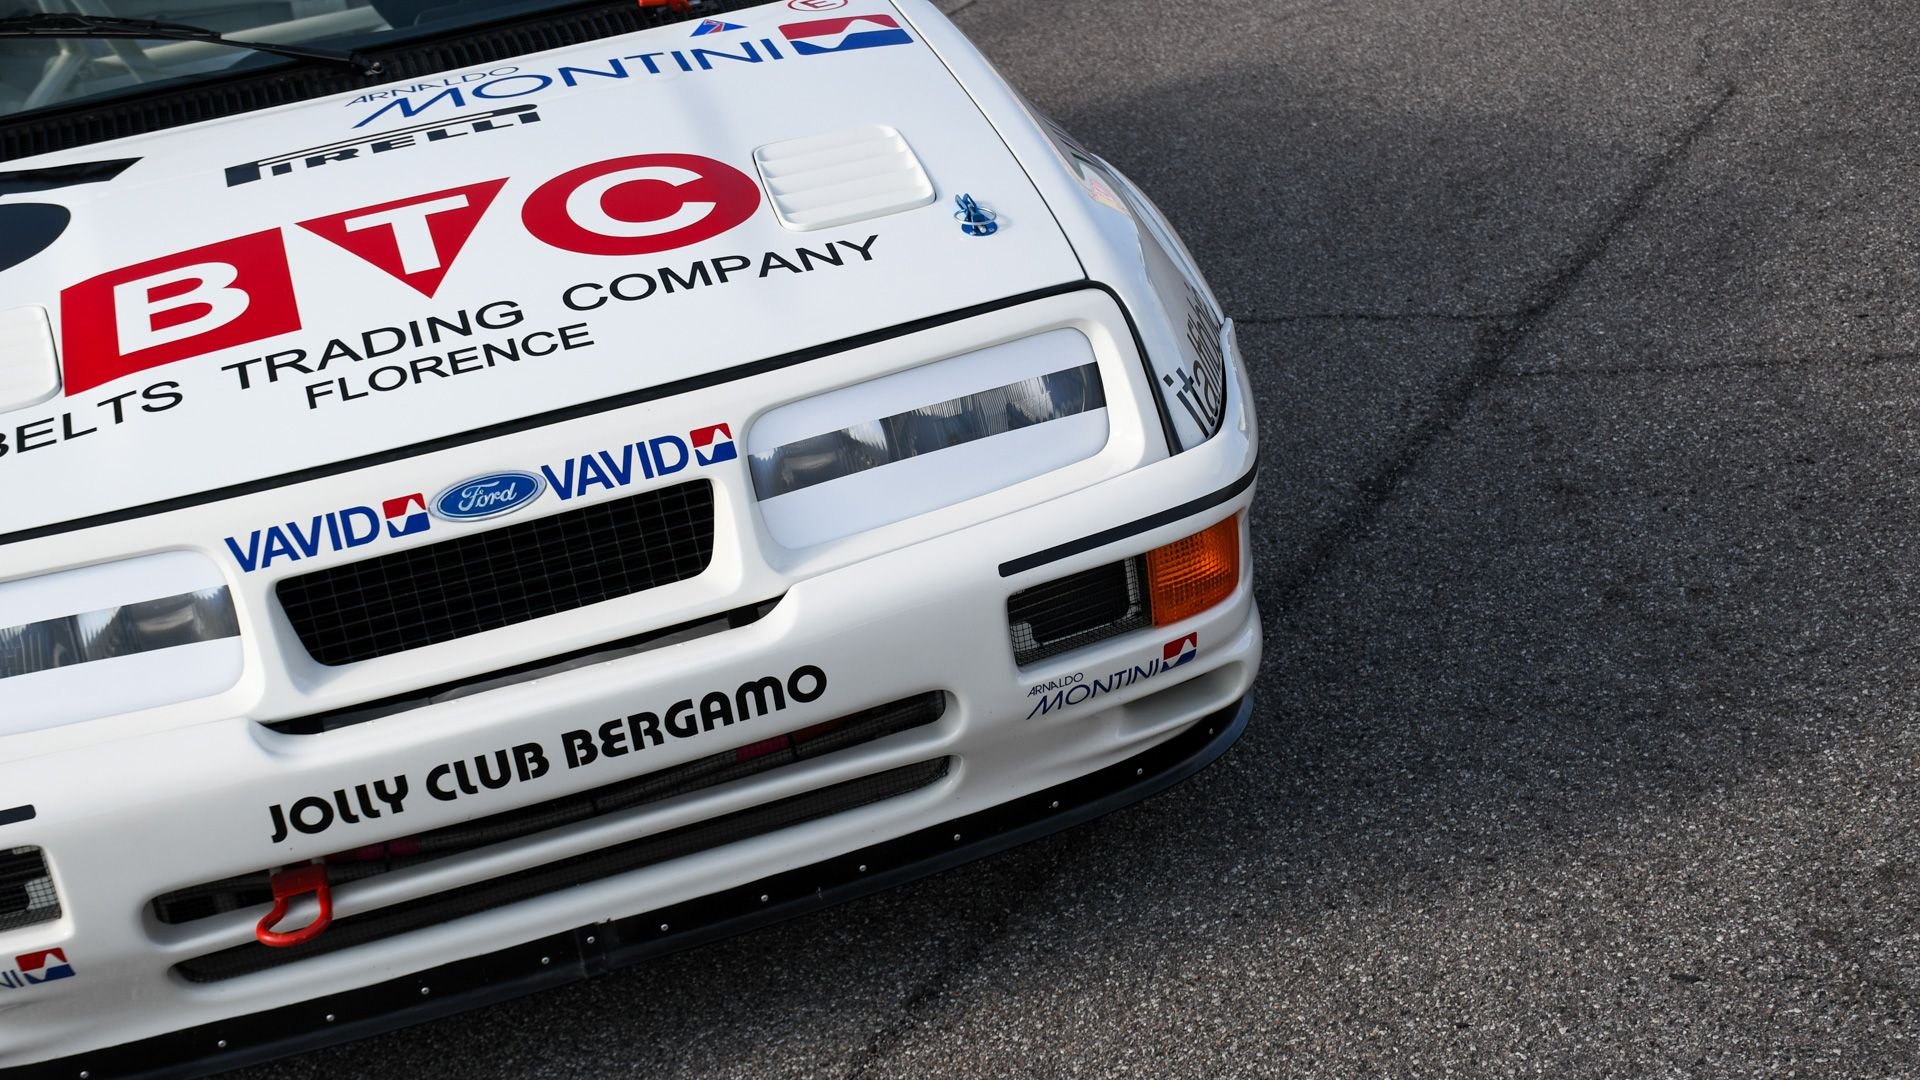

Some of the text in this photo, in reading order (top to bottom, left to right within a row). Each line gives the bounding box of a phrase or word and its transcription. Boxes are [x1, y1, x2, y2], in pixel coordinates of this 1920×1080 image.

[345, 66, 519, 107] ARNALDO
[352, 38, 783, 129] MONTINI
[225, 104, 541, 188] PIRELLI
[0, 234, 879, 458] ELTS TRADING COMPANY
[305, 322, 594, 410] FLORENCE
[458, 481, 517, 511] Ford
[541, 435, 690, 501] VAVID
[225, 506, 381, 573] VAVID
[1025, 657, 1163, 721] MONTINI
[1027, 672, 1084, 698] ARNALDO
[269, 664, 828, 844] JOLLY CLUB BERGAMO
